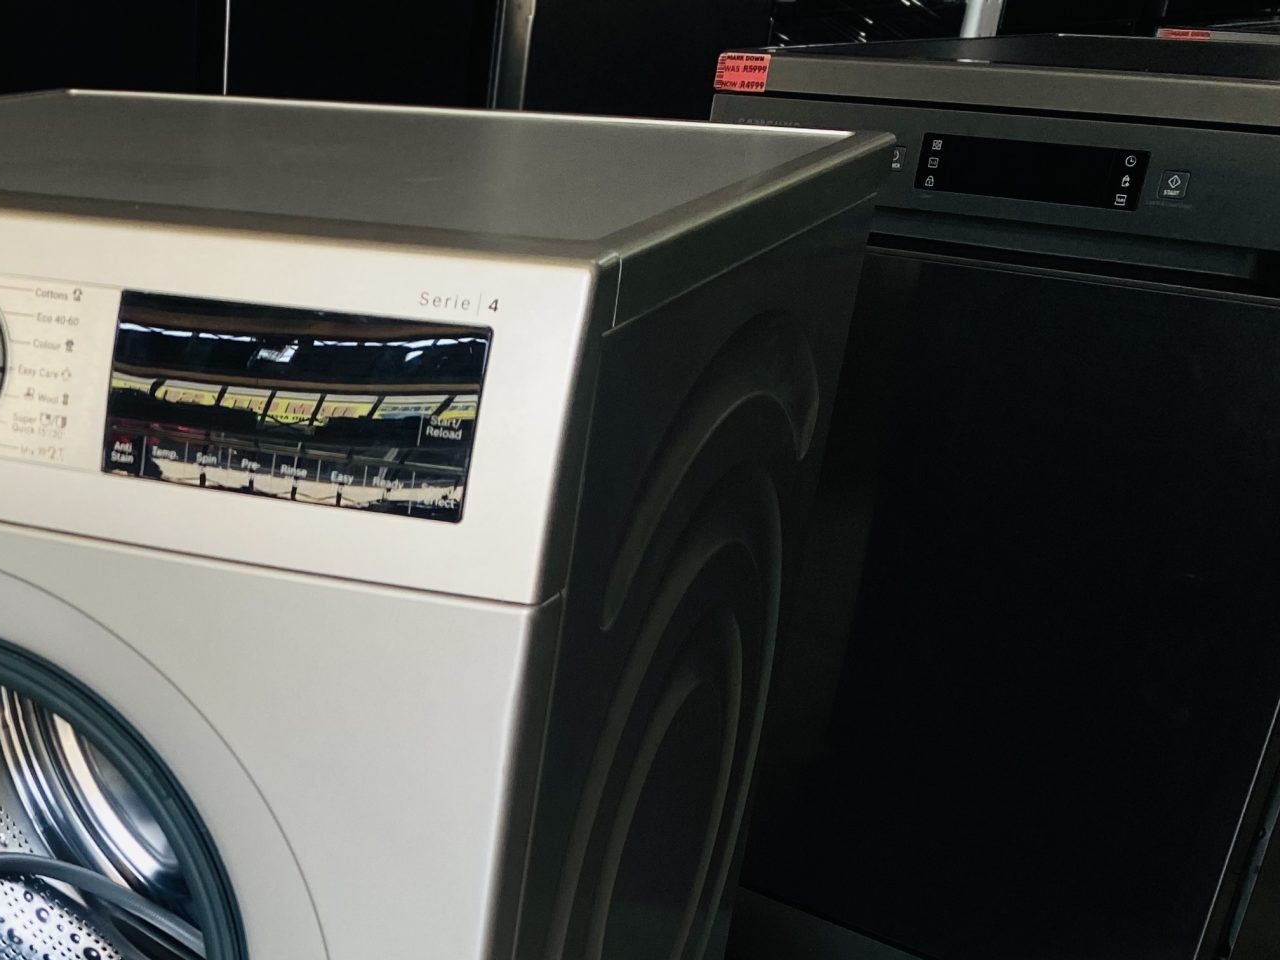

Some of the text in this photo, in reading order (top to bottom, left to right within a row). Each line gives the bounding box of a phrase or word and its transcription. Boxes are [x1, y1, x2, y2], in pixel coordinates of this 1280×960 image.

[35, 287, 68, 301] Cottons
[419, 291, 499, 312] Serie 4
[36, 311, 52, 323] Eco
[430, 416, 462, 428] Start/
[426, 427, 463, 441] Reload
[113, 441, 133, 451] Anti
[152, 445, 179, 460] Temp.
[111, 450, 134, 464] Stain
[195, 451, 218, 466] Spin
[280, 464, 308, 478] Rinse
[330, 471, 354, 486] Easy
[372, 476, 404, 490] Ready
